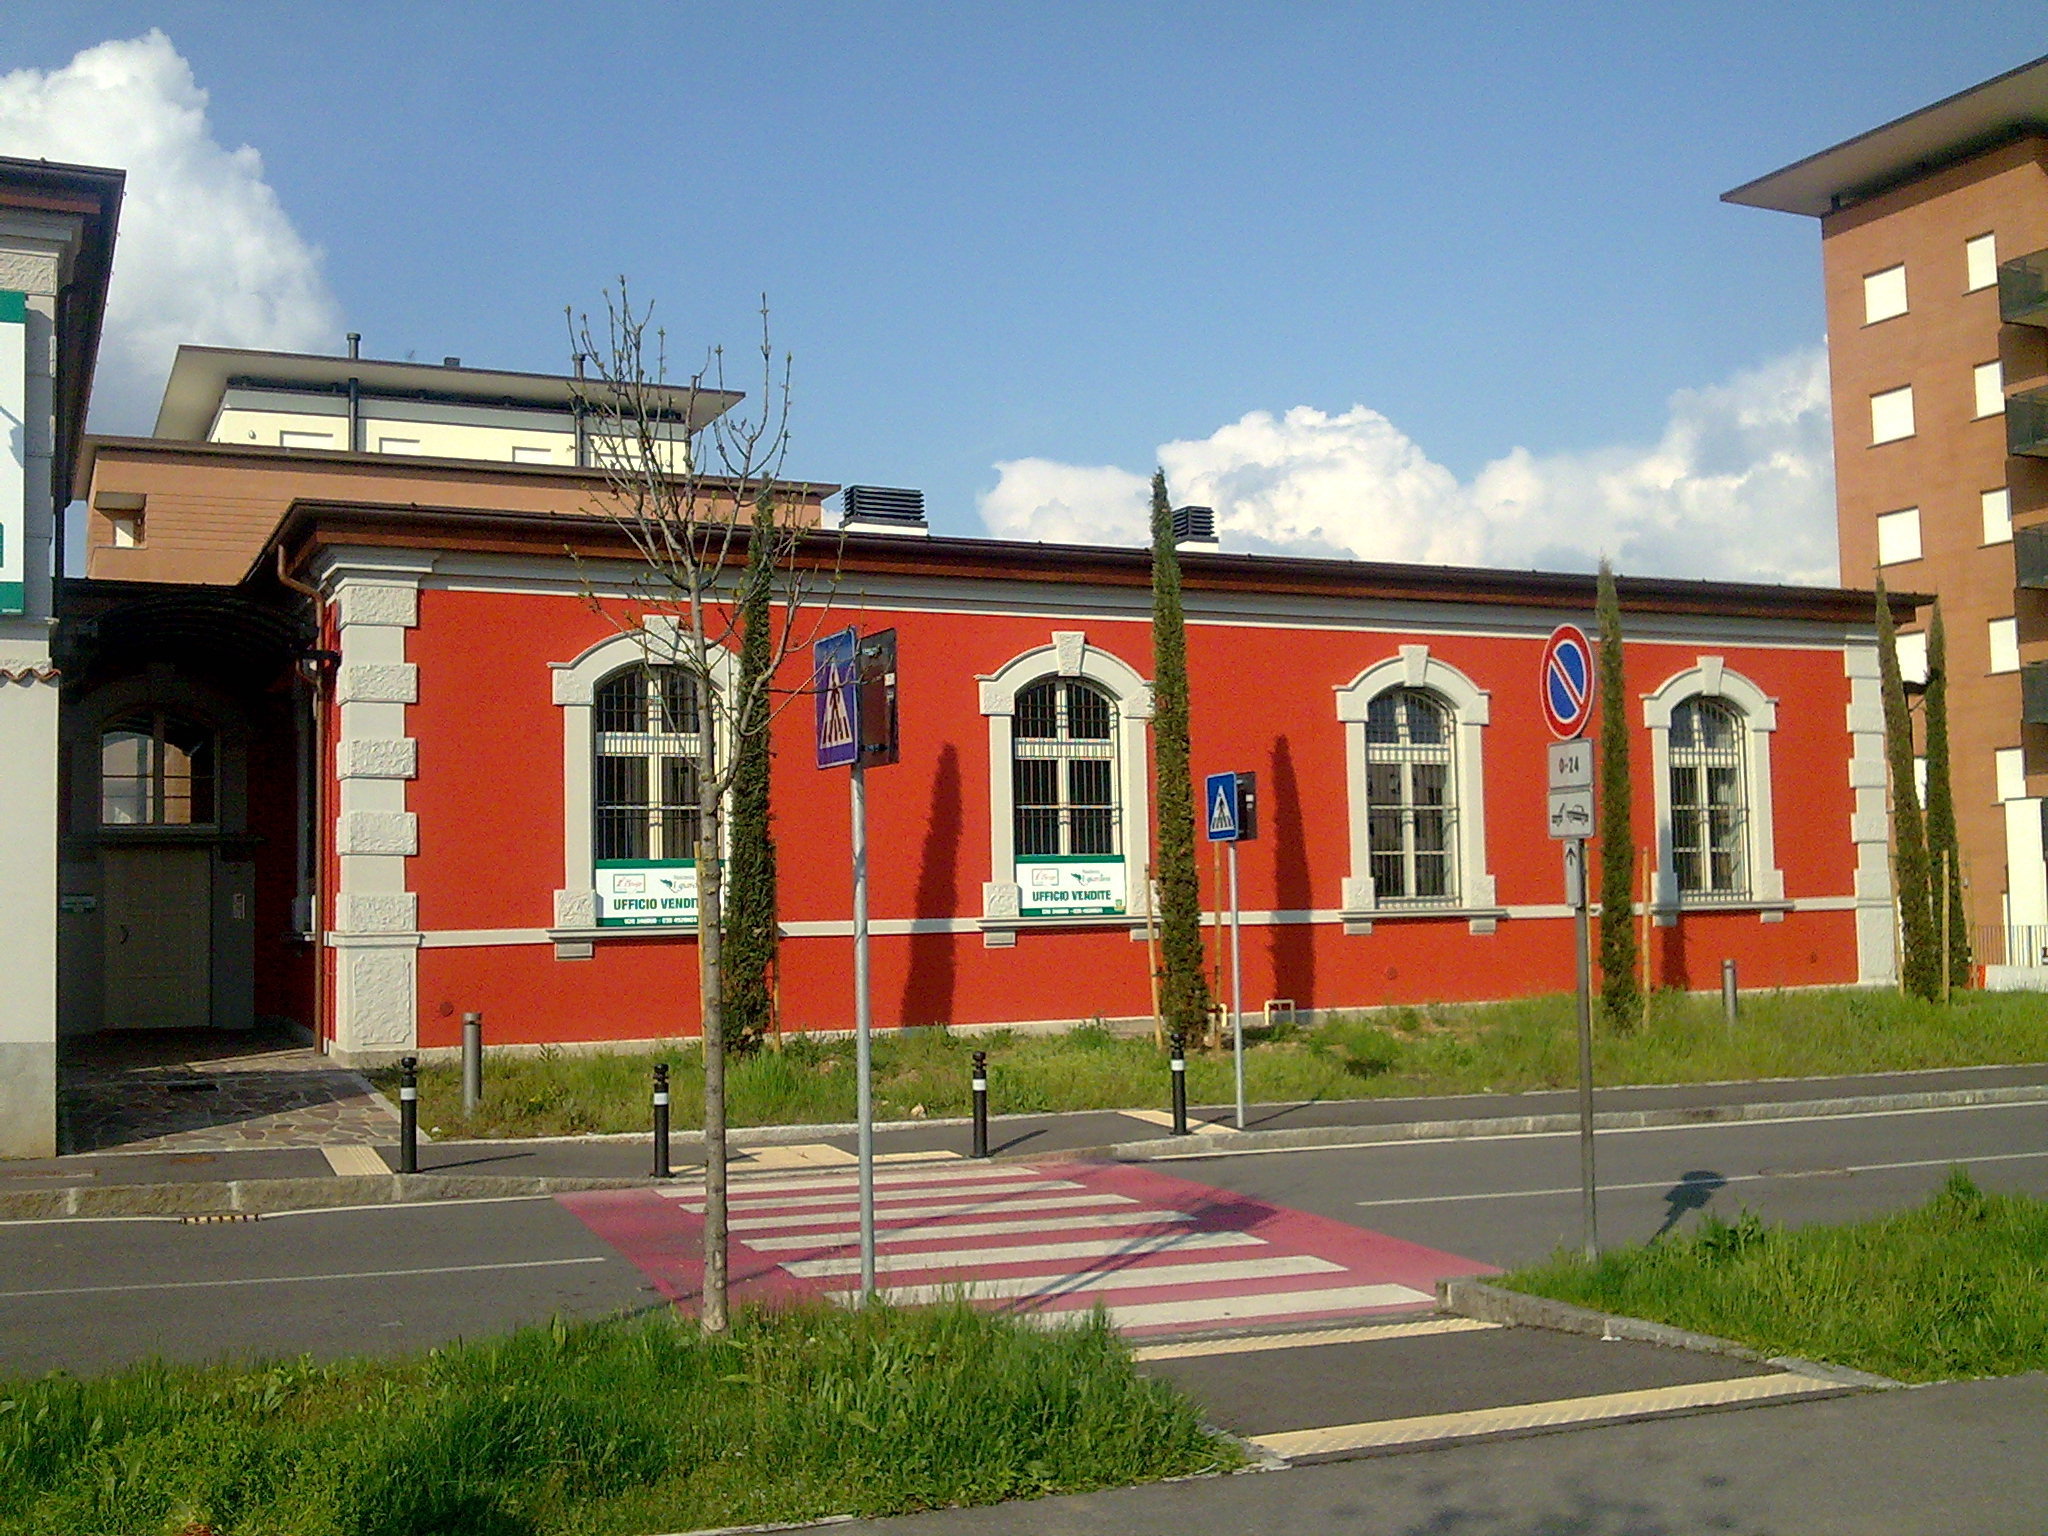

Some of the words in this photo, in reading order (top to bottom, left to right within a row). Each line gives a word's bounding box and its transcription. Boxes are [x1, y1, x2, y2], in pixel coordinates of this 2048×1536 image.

[1559, 756, 1579, 774] 0-24
[1032, 890, 1069, 902] UFFICIO
[1071, 890, 1111, 901] VENDITE
[613, 898, 657, 910] UFFICIO
[660, 897, 699, 909] VENDIT
